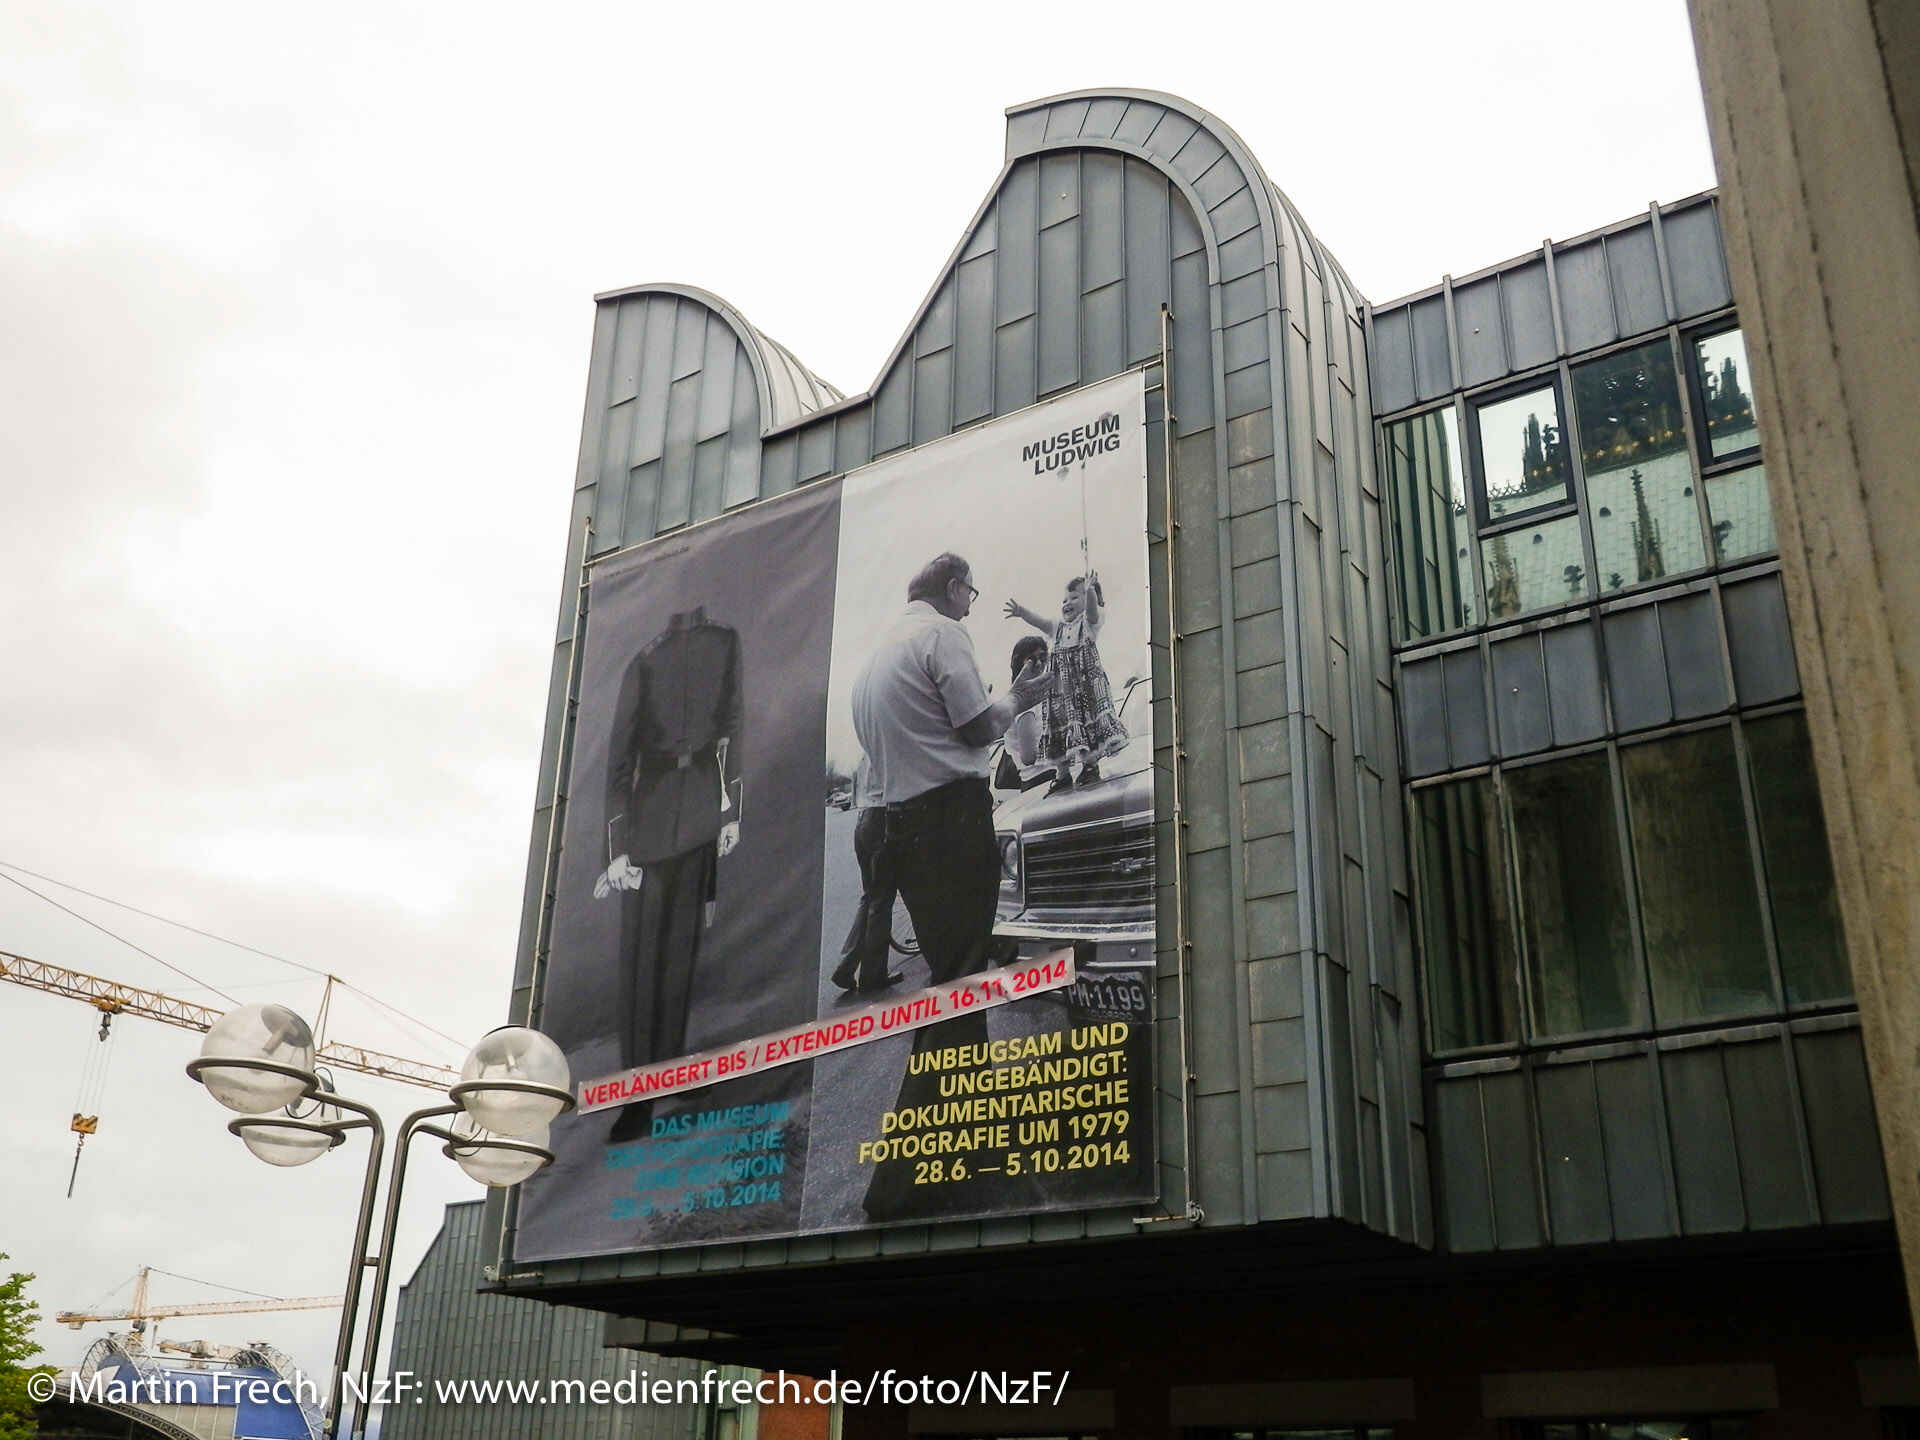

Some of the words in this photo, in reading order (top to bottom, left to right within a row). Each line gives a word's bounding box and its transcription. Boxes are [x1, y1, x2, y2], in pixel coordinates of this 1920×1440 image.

[1022, 414, 1120, 462] MUSEUM
[1034, 434, 1120, 475] LUDWIG
[584, 1059, 713, 1105] VERLÄNGERT
[717, 1051, 746, 1075] BIS
[765, 1016, 875, 1062] EXTENDED
[881, 996, 942, 1030] UNTIL
[909, 1031, 1062, 1076] UNBEUGSAM
[1071, 1022, 1129, 1052] UND
[939, 1050, 1128, 1098] UNGEBÄNDIGT:
[652, 1114, 690, 1138] DAS
[697, 1101, 790, 1132] MUSEUM
[881, 1079, 1129, 1134] DOKUMENTARISCHE
[858, 1124, 1010, 1165] FOTOGRAFIE
[1018, 1119, 1060, 1146] UM
[1068, 1110, 1130, 1139] 1979
[914, 1158, 972, 1185] 28.6.
[1006, 1140, 1130, 1177] 5.10.2014
